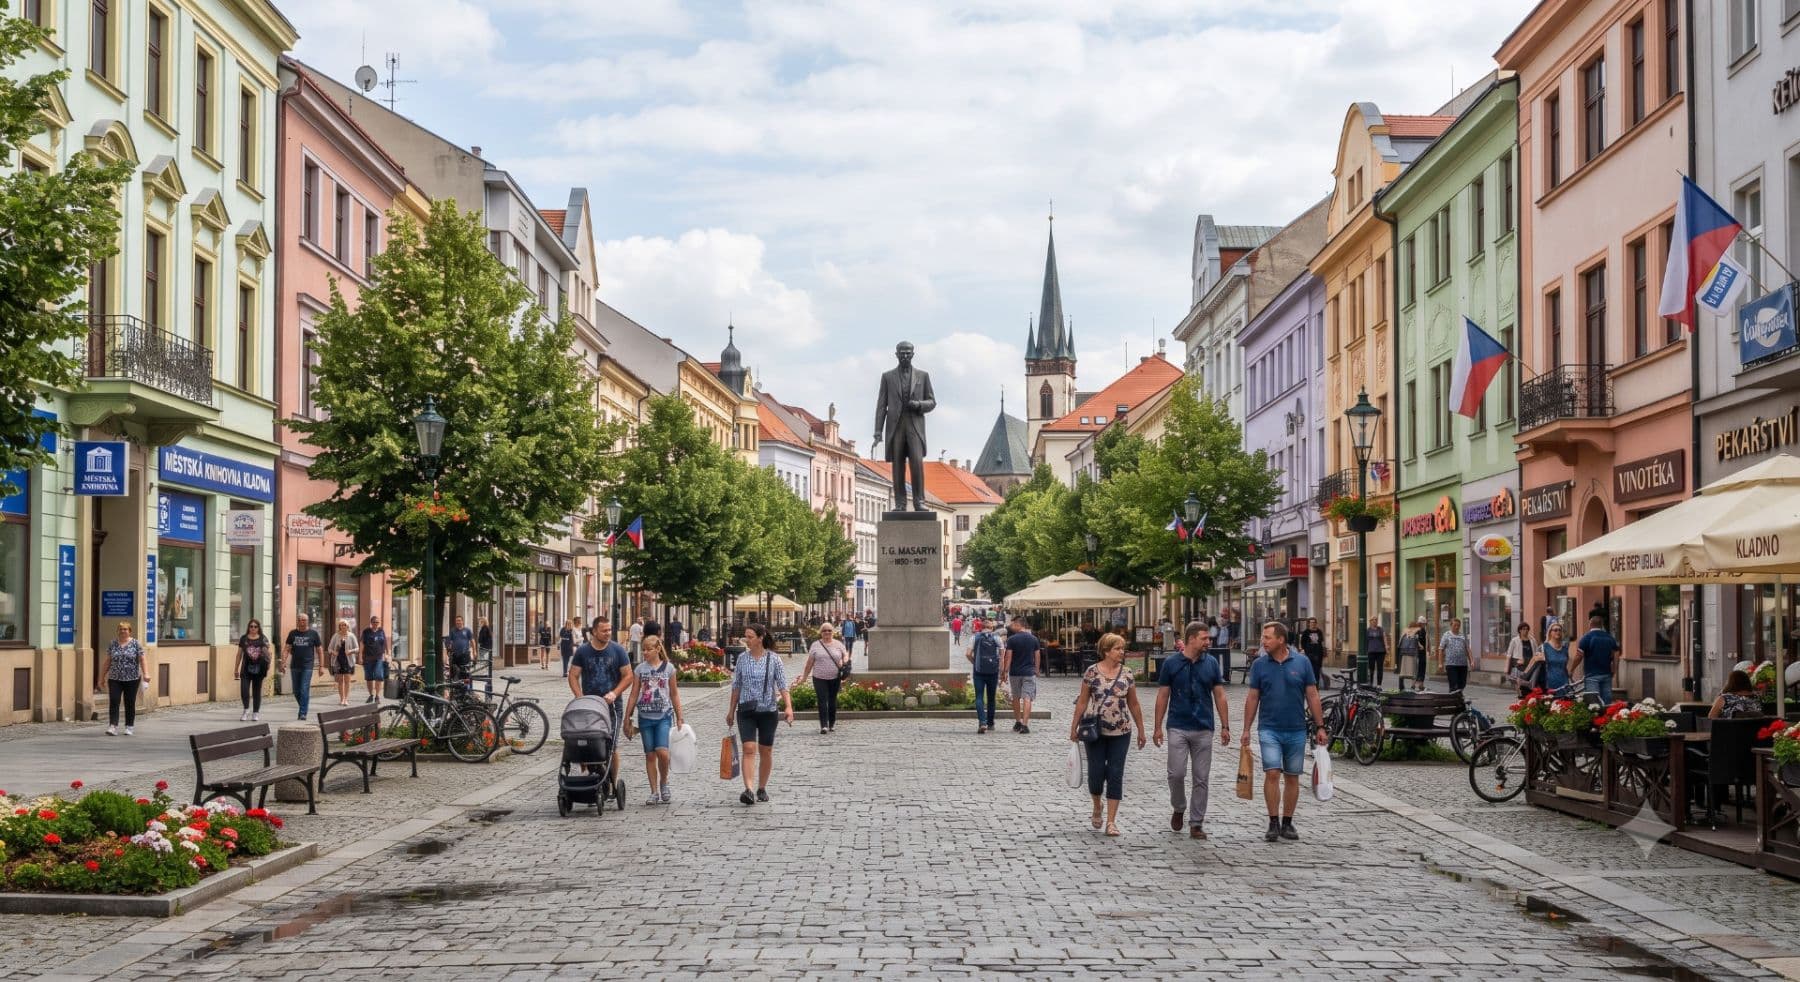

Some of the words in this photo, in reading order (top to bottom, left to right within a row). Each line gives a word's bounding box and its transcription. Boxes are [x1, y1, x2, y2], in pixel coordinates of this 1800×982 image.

[1715, 406, 1795, 462] PEKAŘSTVÍ
[165, 450, 203, 478] MĚSTSKÁ
[204, 463, 241, 487] KNIHOVNA
[1619, 458, 1675, 495] VINOTÉKA
[898, 546, 937, 555] MASARYK
[1736, 534, 1780, 559] KLADNO
[1559, 561, 1586, 579] KLADNO
[1610, 554, 1626, 573] CAFÉ
[1626, 552, 1665, 572] REPUBLIKA
